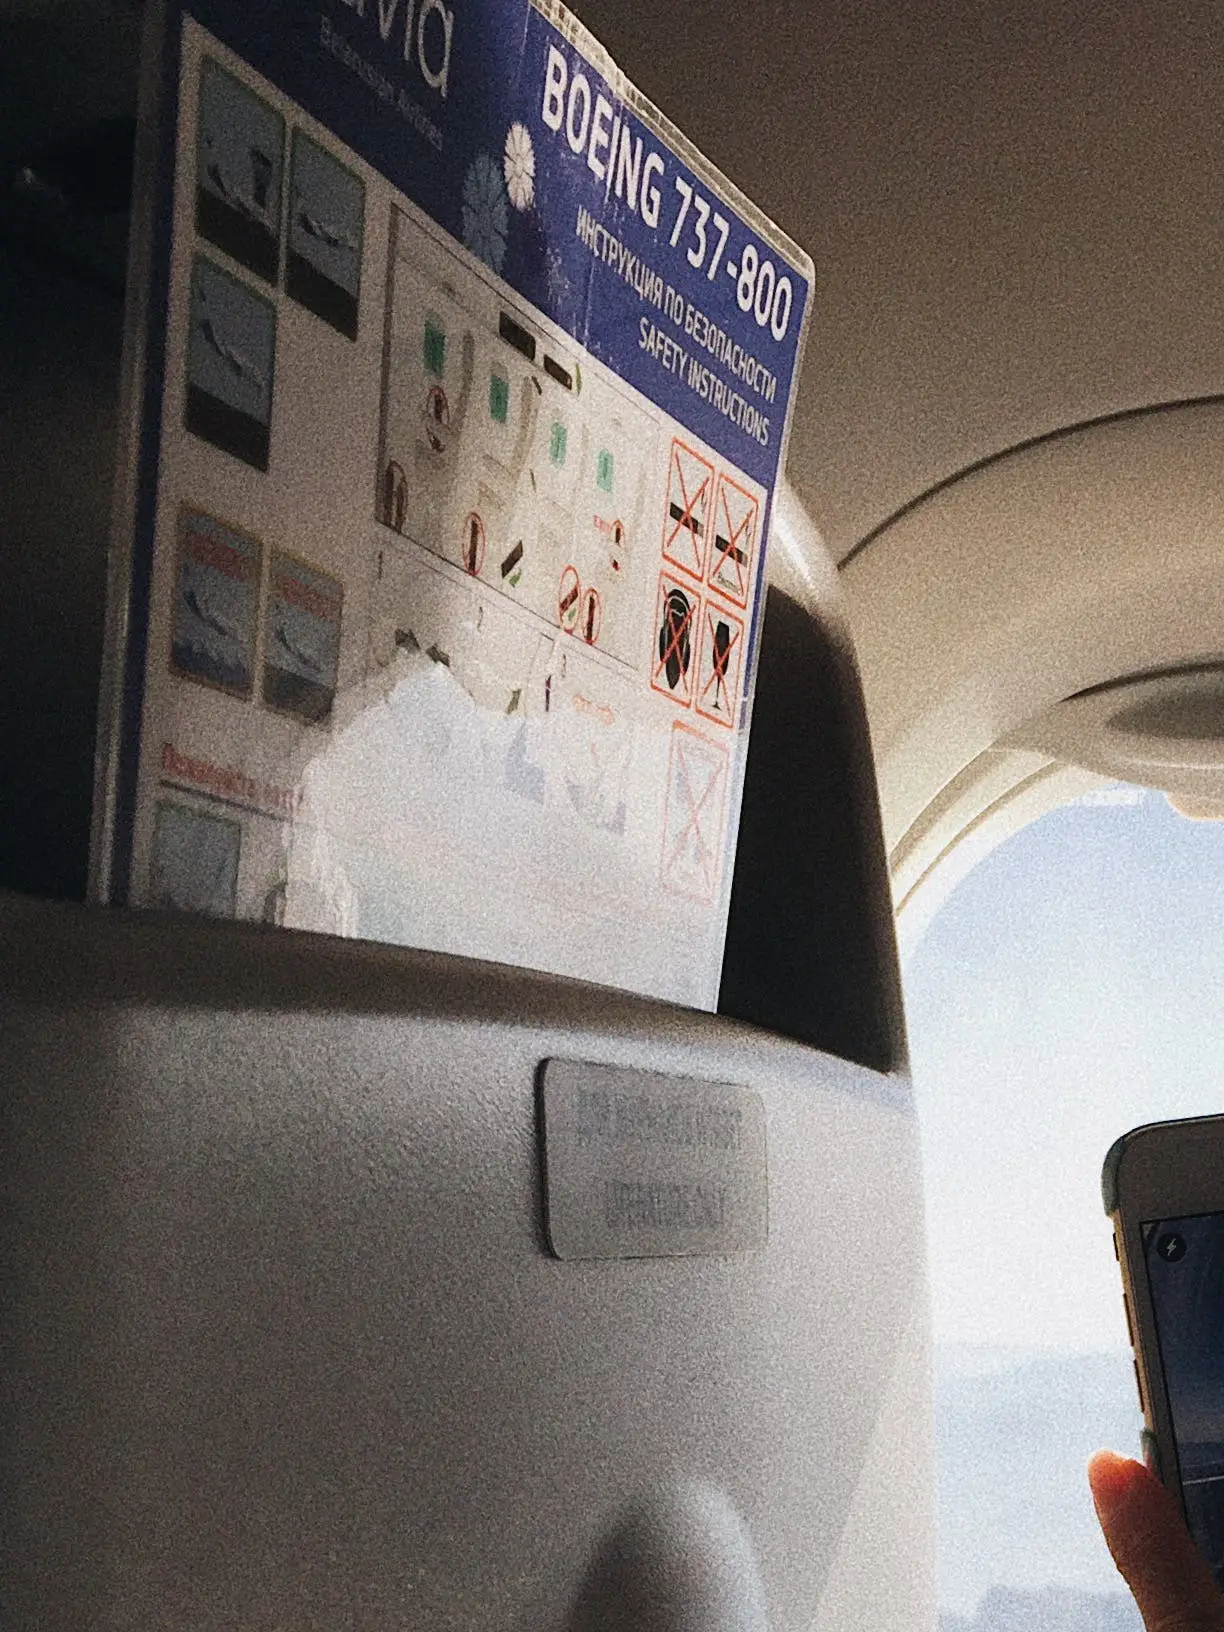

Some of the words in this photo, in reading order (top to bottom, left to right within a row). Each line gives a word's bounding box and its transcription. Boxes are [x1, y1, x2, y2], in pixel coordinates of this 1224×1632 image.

[542, 43, 665, 228] BOEING
[669, 176, 793, 342] 737-800
[575, 204, 665, 310] ИНСТРУКЦИЯ
[664, 284, 685, 326] ПО
[684, 303, 777, 404] БЕЗОПАСНОСТИ
[638, 316, 688, 380] SAFETY
[687, 357, 770, 447] INSTRUCTIONS
